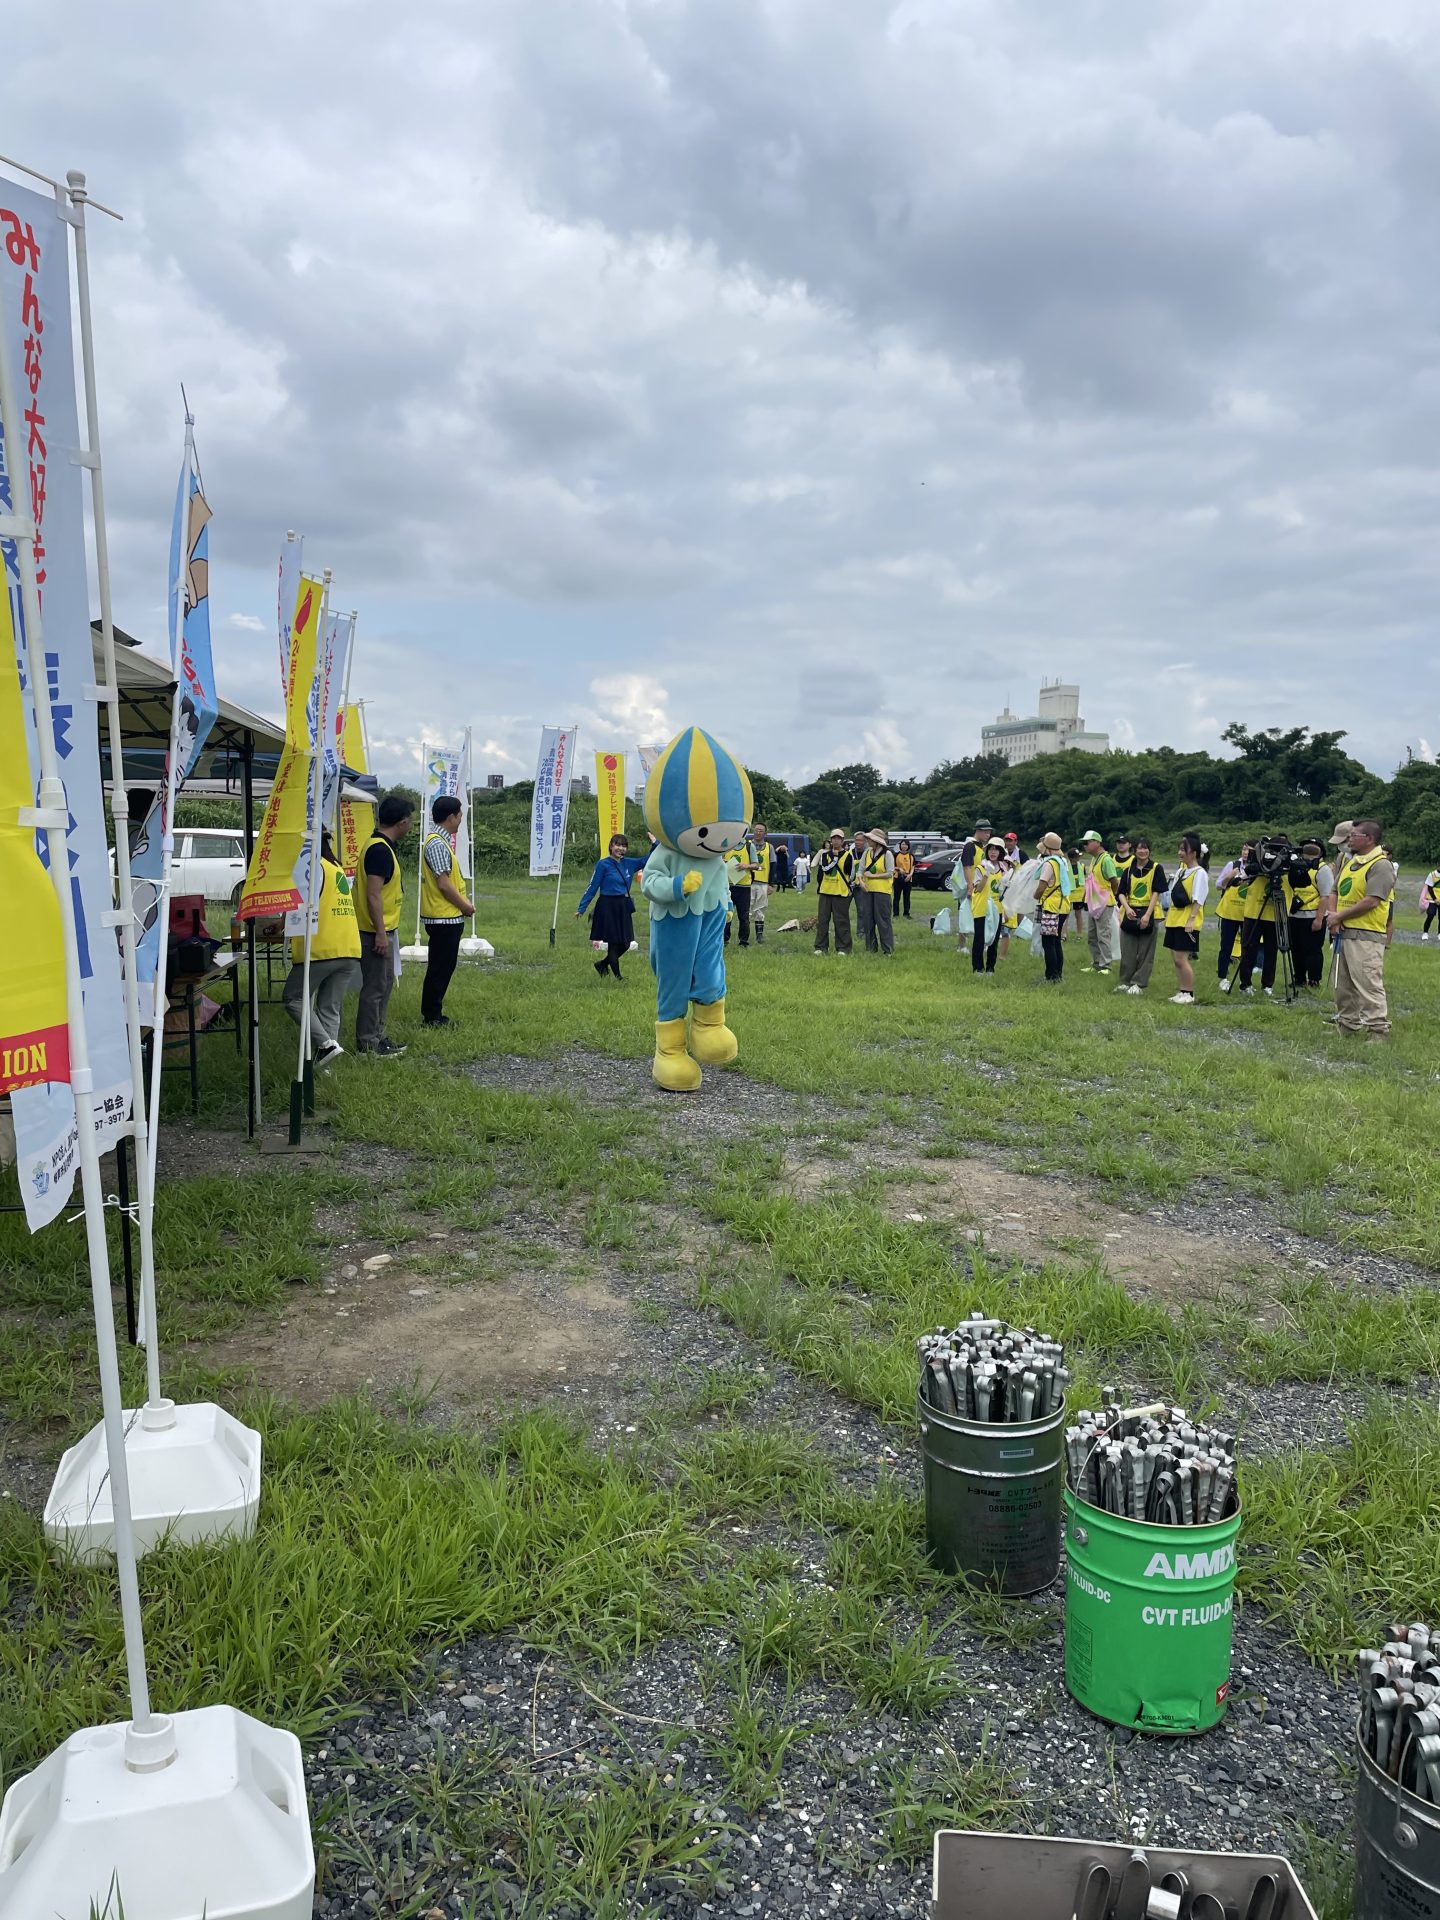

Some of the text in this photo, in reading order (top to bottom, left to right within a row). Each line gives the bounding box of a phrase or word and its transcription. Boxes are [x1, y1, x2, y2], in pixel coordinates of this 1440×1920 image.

[551, 734, 567, 861] みんな大好き！ 長良川！
[1143, 1539, 1236, 1580] AMMIX
[1073, 1571, 1111, 1604] FLUID-DC
[1142, 1606, 1179, 1626] CVT
